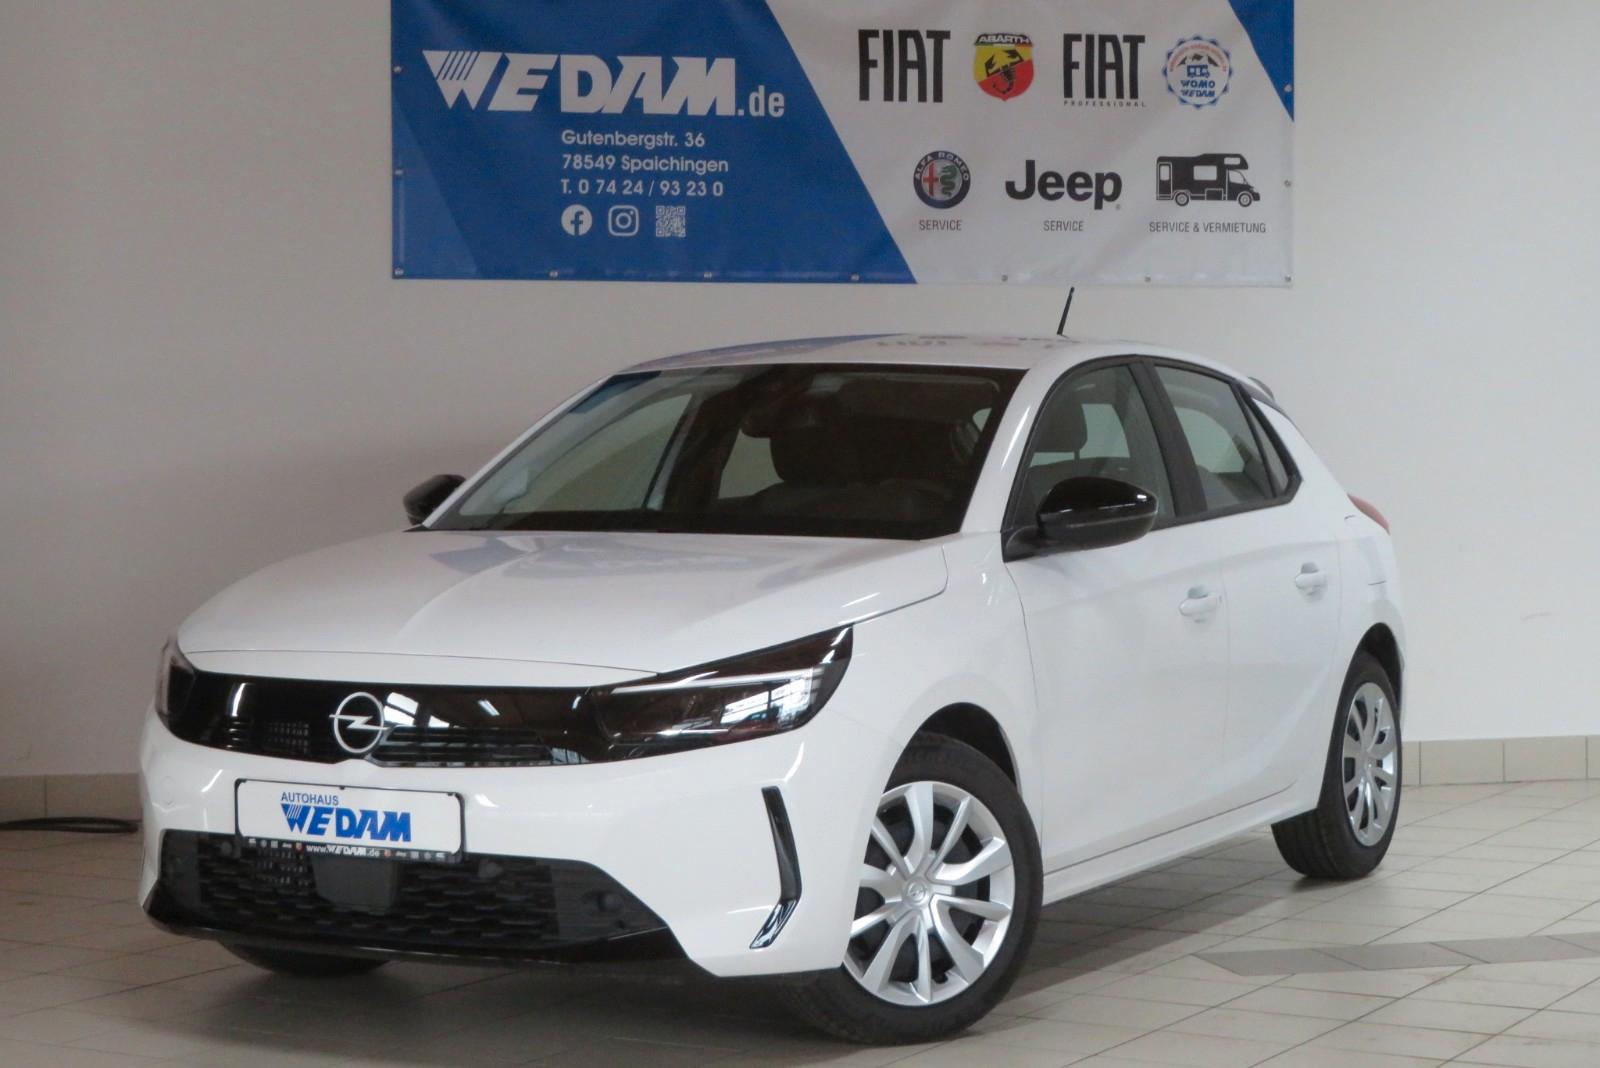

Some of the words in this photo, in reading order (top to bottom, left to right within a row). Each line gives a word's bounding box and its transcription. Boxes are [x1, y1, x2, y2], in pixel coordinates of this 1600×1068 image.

[977, 34, 1031, 44] ABARTH
[858, 29, 951, 104] FIAT
[1063, 33, 1146, 100] FIAT
[1180, 79, 1216, 89] WOMO
[1063, 100, 1146, 108] PROFESSIONAL
[561, 130, 678, 150] Gutenbergstr.
[684, 131, 706, 148] 36
[562, 154, 616, 171] 78549
[621, 155, 729, 175] Spaichingen
[914, 153, 934, 180] ALFA
[937, 151, 971, 182] ROMEO
[561, 179, 573, 195] T.
[577, 180, 588, 195] 0
[595, 180, 617, 196] 74
[622, 180, 644, 196] 24
[659, 181, 681, 197] 93
[686, 181, 709, 197] 23
[712, 181, 724, 197] 0
[1005, 159, 1122, 210] Jeep
[919, 219, 962, 231] SERVICE
[1043, 220, 1084, 232] SERVICE
[1149, 221, 1190, 233] SERVICE
[1192, 221, 1200, 233] &
[1202, 221, 1267, 234] VERMIETUNG
[281, 791, 339, 806] AUTOHAUS
[280, 803, 412, 842] WEDAM
[306, 843, 380, 857] www.WEDAM.de
